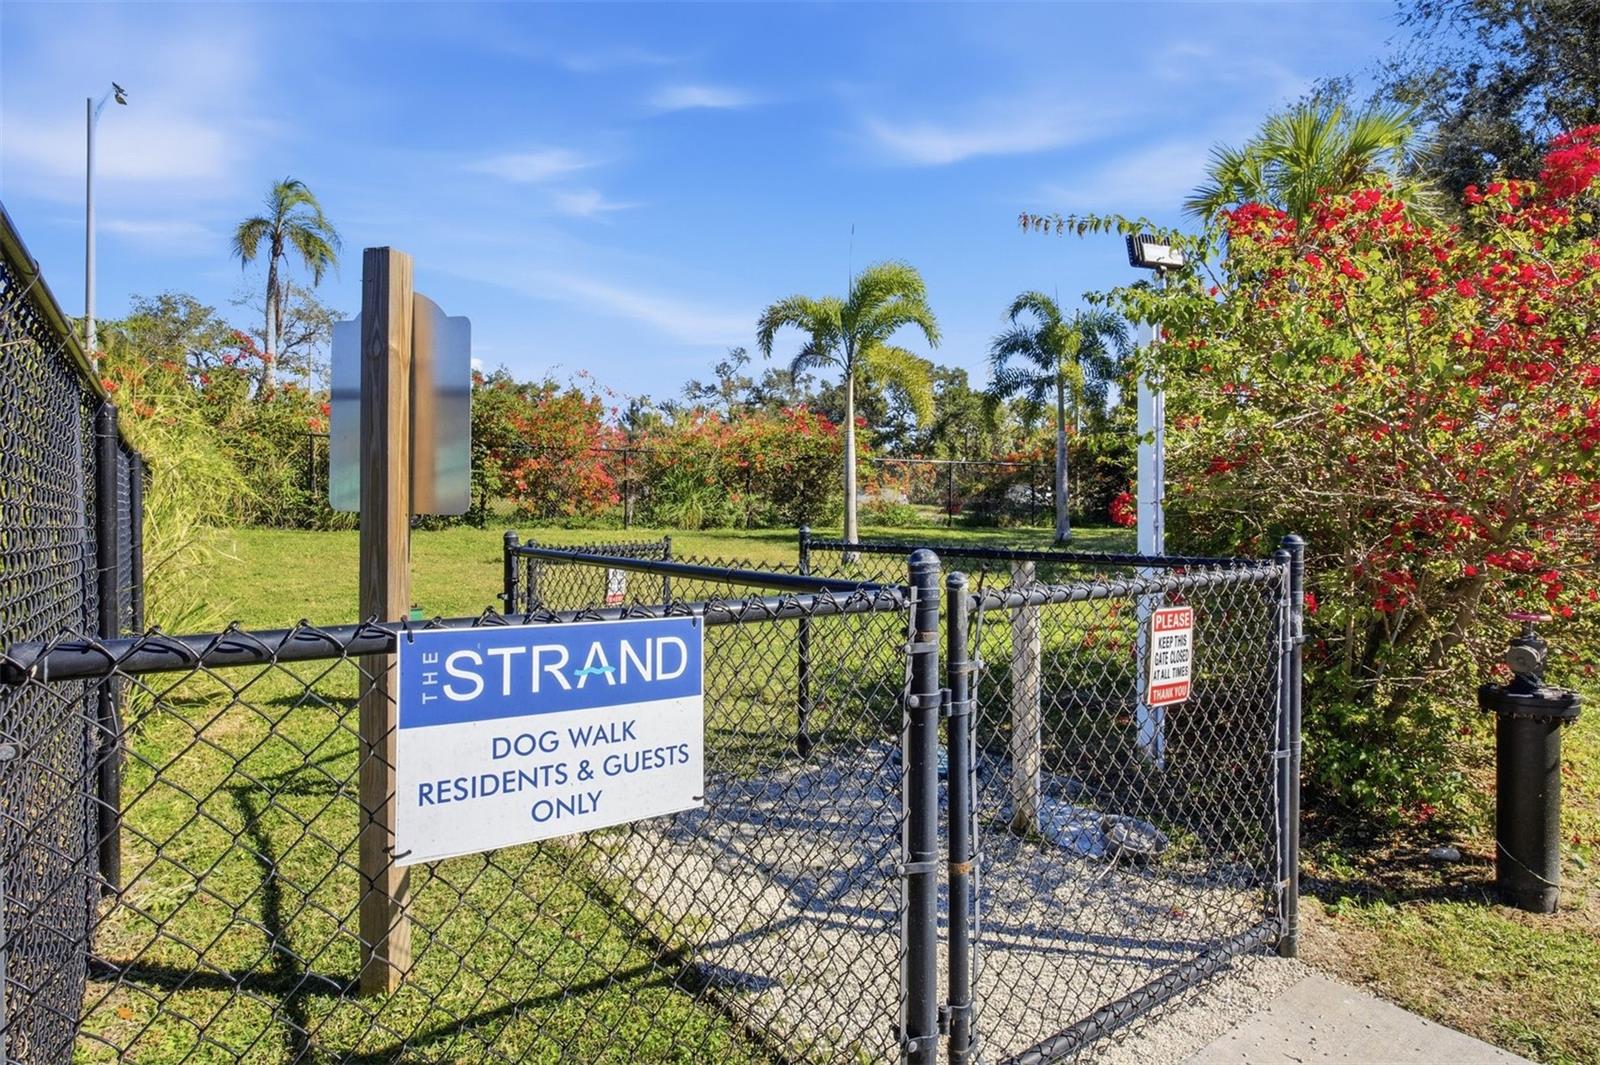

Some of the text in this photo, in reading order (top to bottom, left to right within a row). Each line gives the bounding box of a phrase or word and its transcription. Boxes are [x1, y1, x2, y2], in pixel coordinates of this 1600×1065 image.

[1156, 612, 1190, 629] PLEASE
[1158, 634, 1187, 649] KEEP THIS
[1155, 649, 1189, 666] GATE CLOSED
[422, 636, 688, 704] THE STRAND
[1153, 665, 1189, 680] AT ALL TIMES
[1153, 687, 1174, 702] THANK
[492, 720, 637, 760] DOG WALK
[418, 743, 690, 807] RESIDENTS & GUESTS
[531, 790, 603, 822] ONLY
